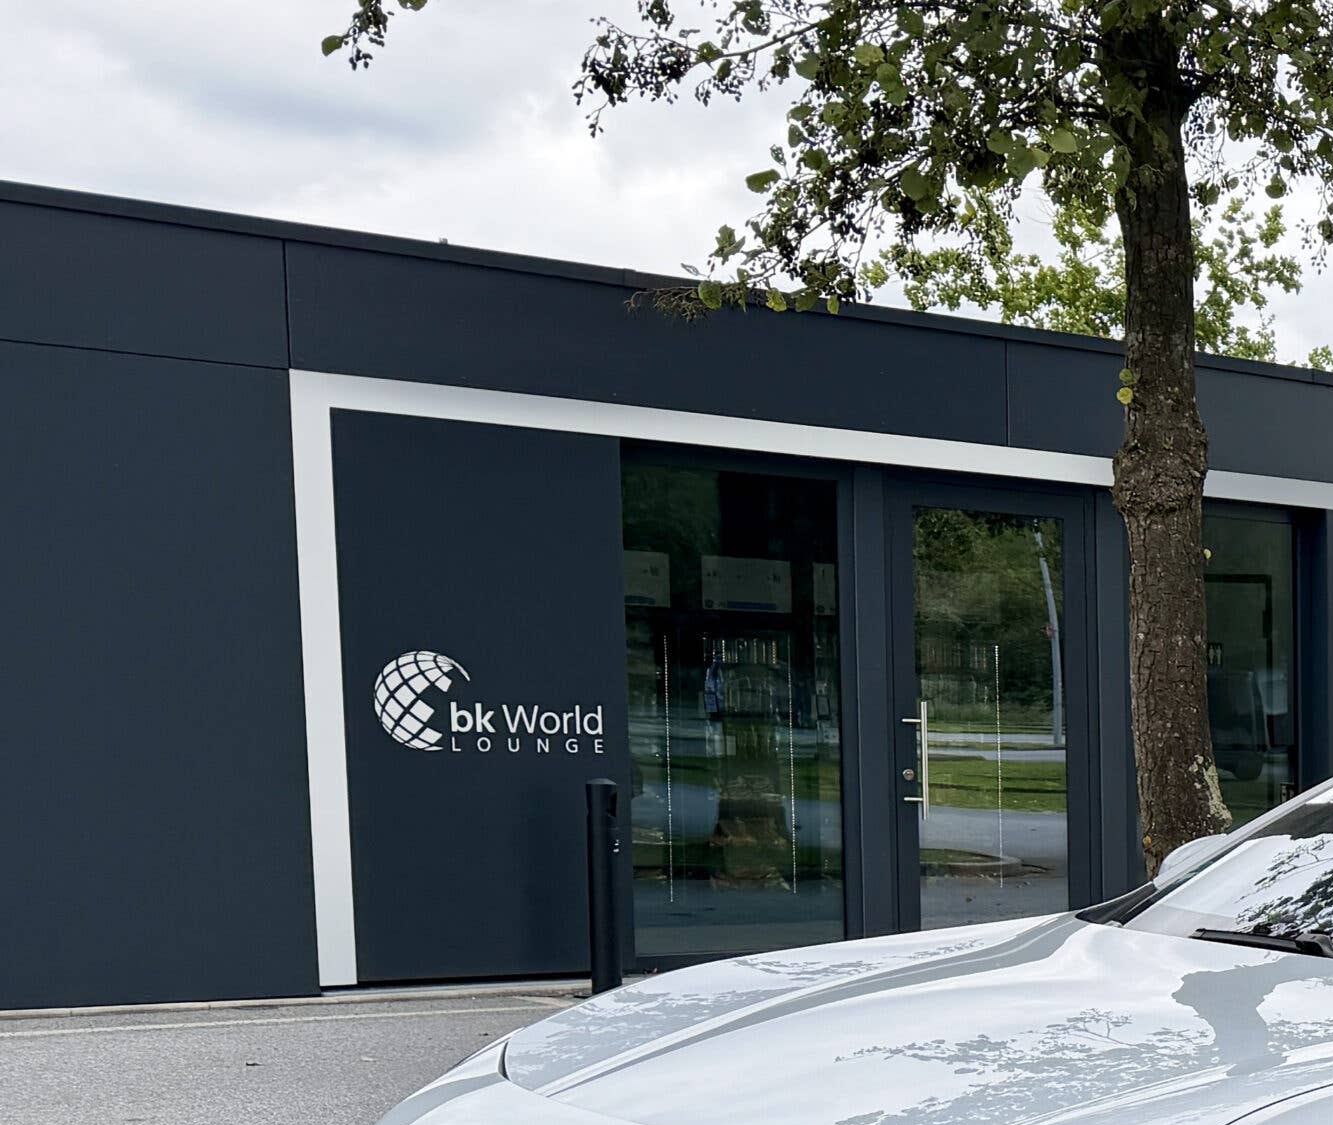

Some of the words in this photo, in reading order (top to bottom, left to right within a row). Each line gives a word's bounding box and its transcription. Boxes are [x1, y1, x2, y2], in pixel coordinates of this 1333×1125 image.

[450, 701, 496, 733] bk
[501, 704, 603, 735] World
[452, 736, 604, 754] LOUNGE
